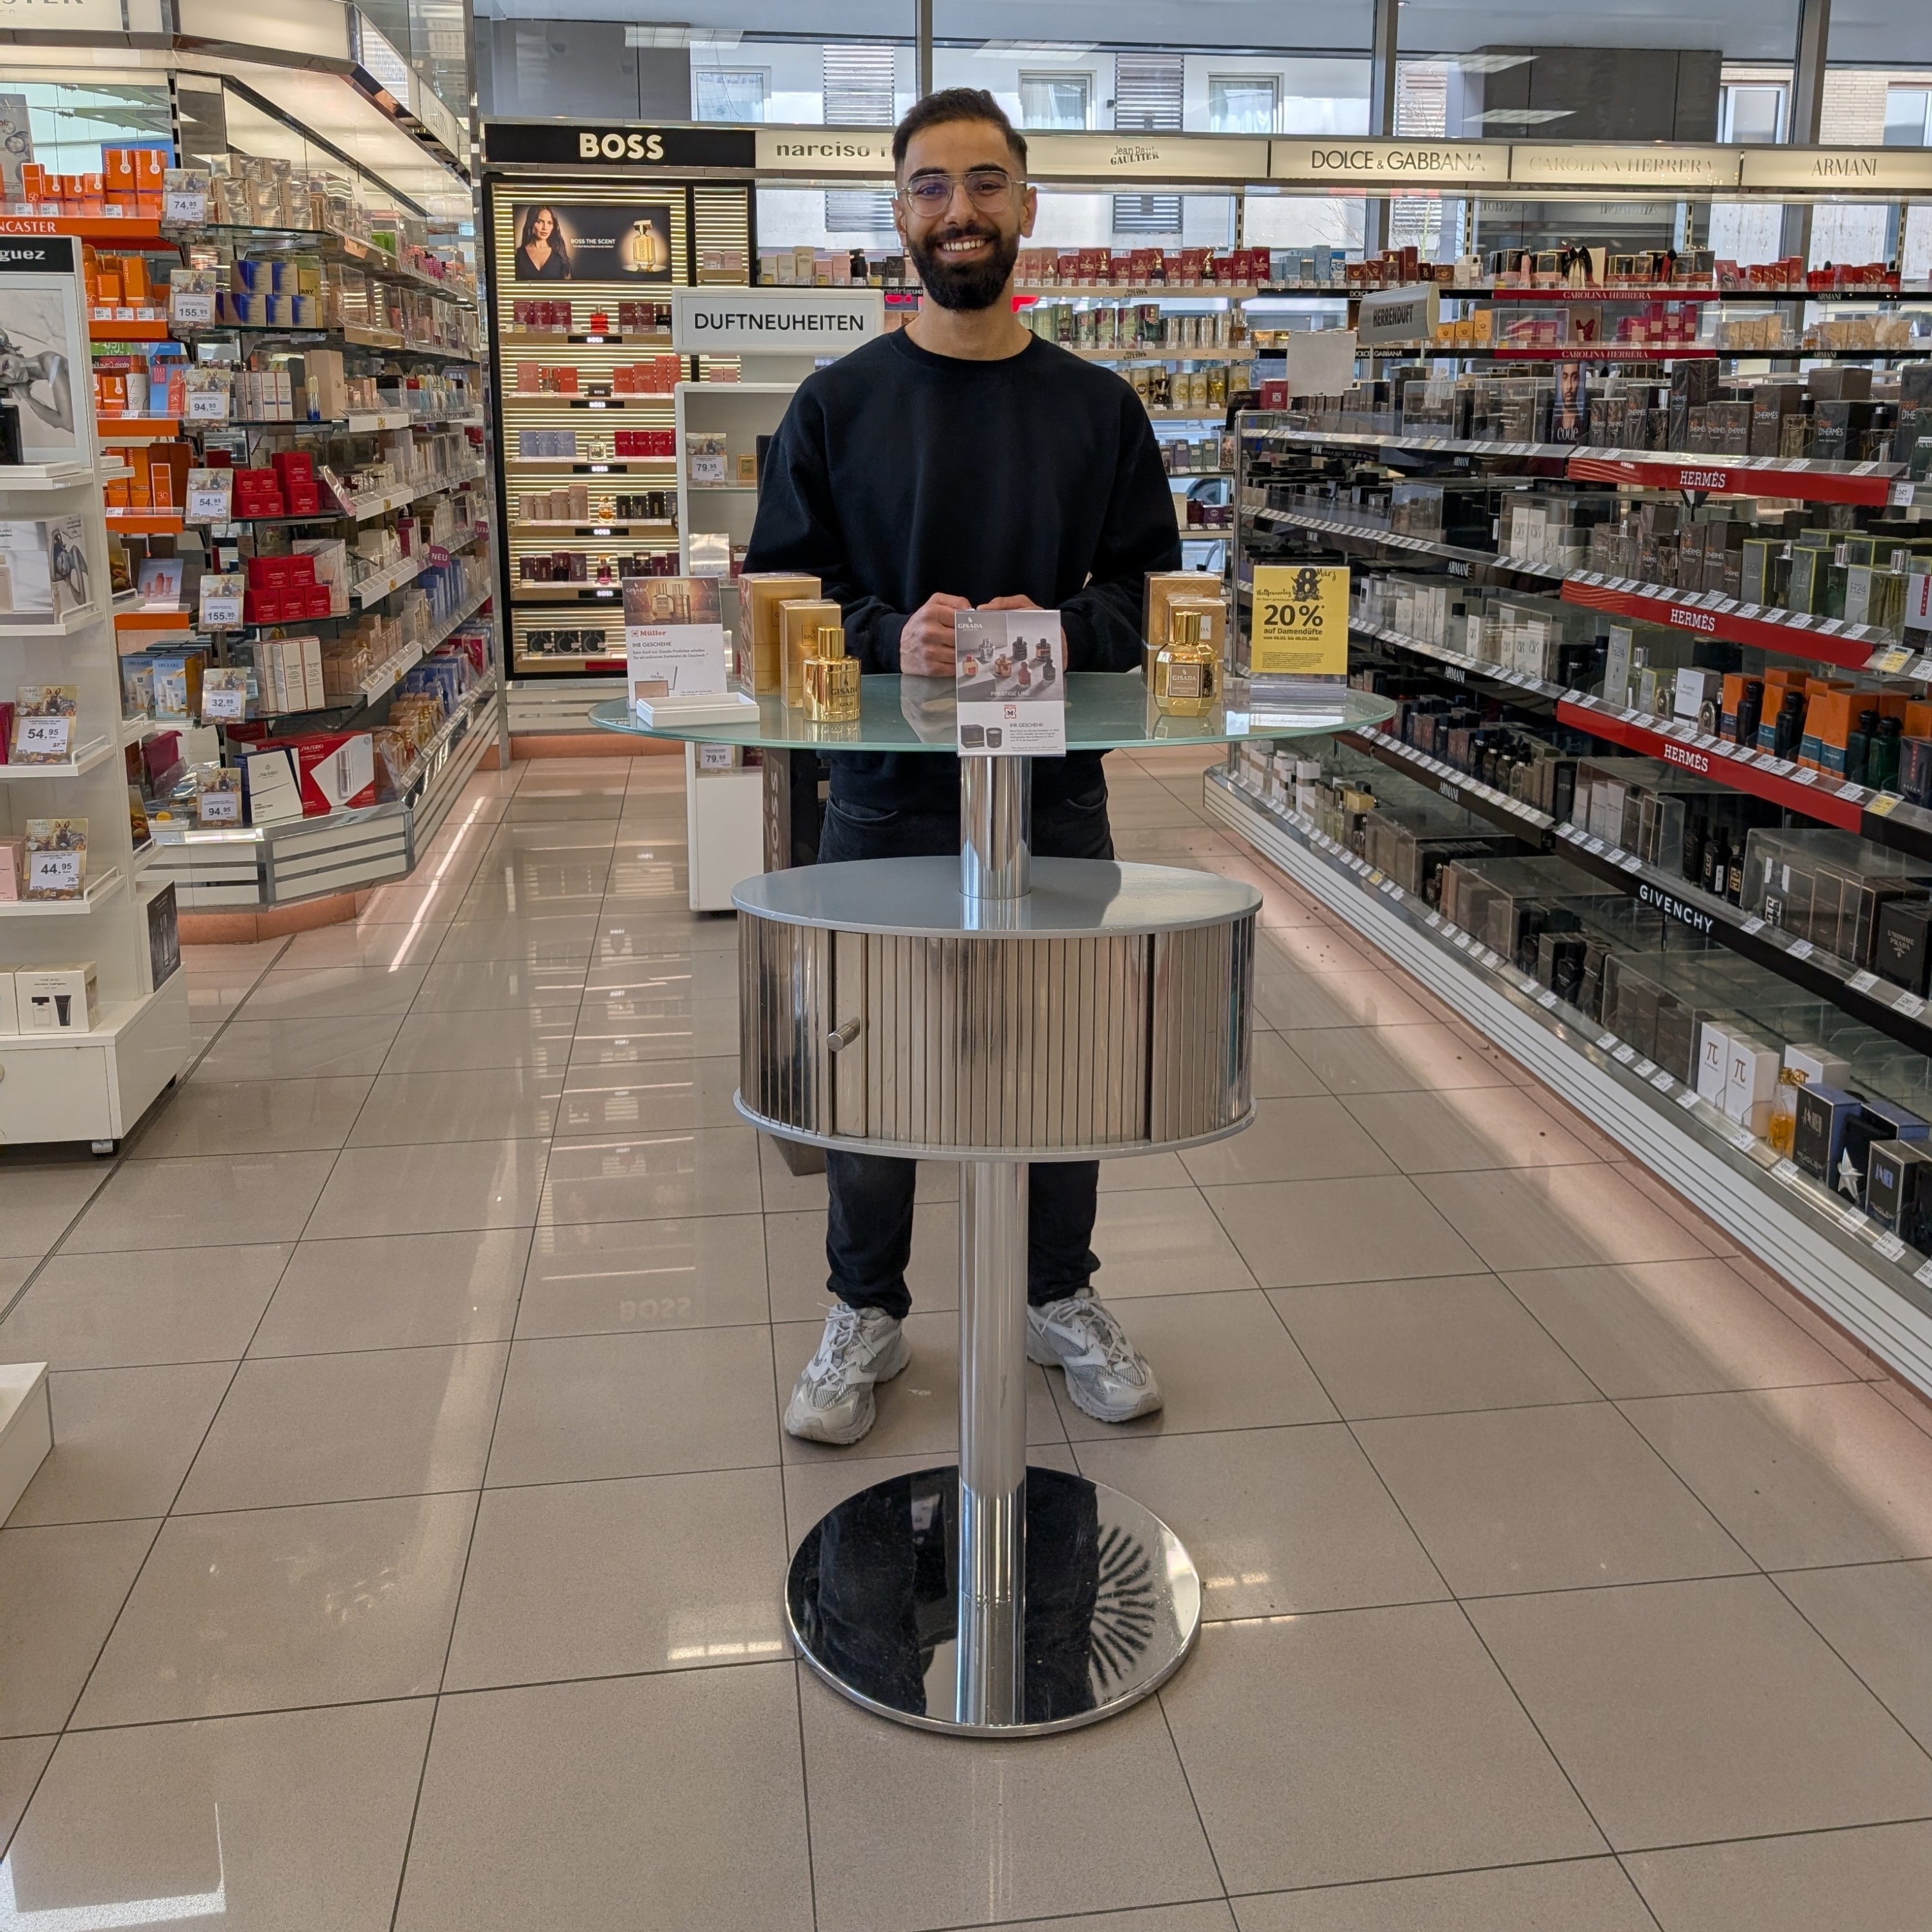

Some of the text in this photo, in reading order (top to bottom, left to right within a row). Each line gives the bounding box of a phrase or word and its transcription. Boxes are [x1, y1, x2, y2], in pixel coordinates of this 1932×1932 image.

[580, 133, 664, 160] BOSS
[777, 141, 870, 157] narciso
[1114, 146, 1134, 155] Jean
[1110, 151, 1159, 166] GAULTIER
[1311, 150, 1485, 171] DOLCE & GABBANA
[1529, 156, 1712, 173] CAROLINA HERRERA
[1811, 159, 1878, 177] ARMANI
[694, 313, 863, 331] DUFTNEUHEITEN
[1557, 427, 1578, 441] code
[1679, 470, 1726, 488] HERMÈS
[431, 552, 448, 562] NEU
[1316, 568, 1336, 582] März
[1448, 560, 1469, 576] ARMANI
[1849, 583, 1867, 595] H24
[207, 612, 235, 621] 155.95
[1670, 608, 1716, 632] HERMÈS
[1444, 666, 1465, 684] ARMANI
[212, 698, 234, 707] 32.95
[27, 729, 59, 739] 54.95
[706, 754, 726, 763] 79.95
[1664, 743, 1709, 772] HERMÈS
[1439, 781, 1459, 802] ARMANI
[209, 806, 231, 816] 94.95
[41, 863, 72, 874] 44.95
[1639, 884, 1714, 934] GIVENCHY
